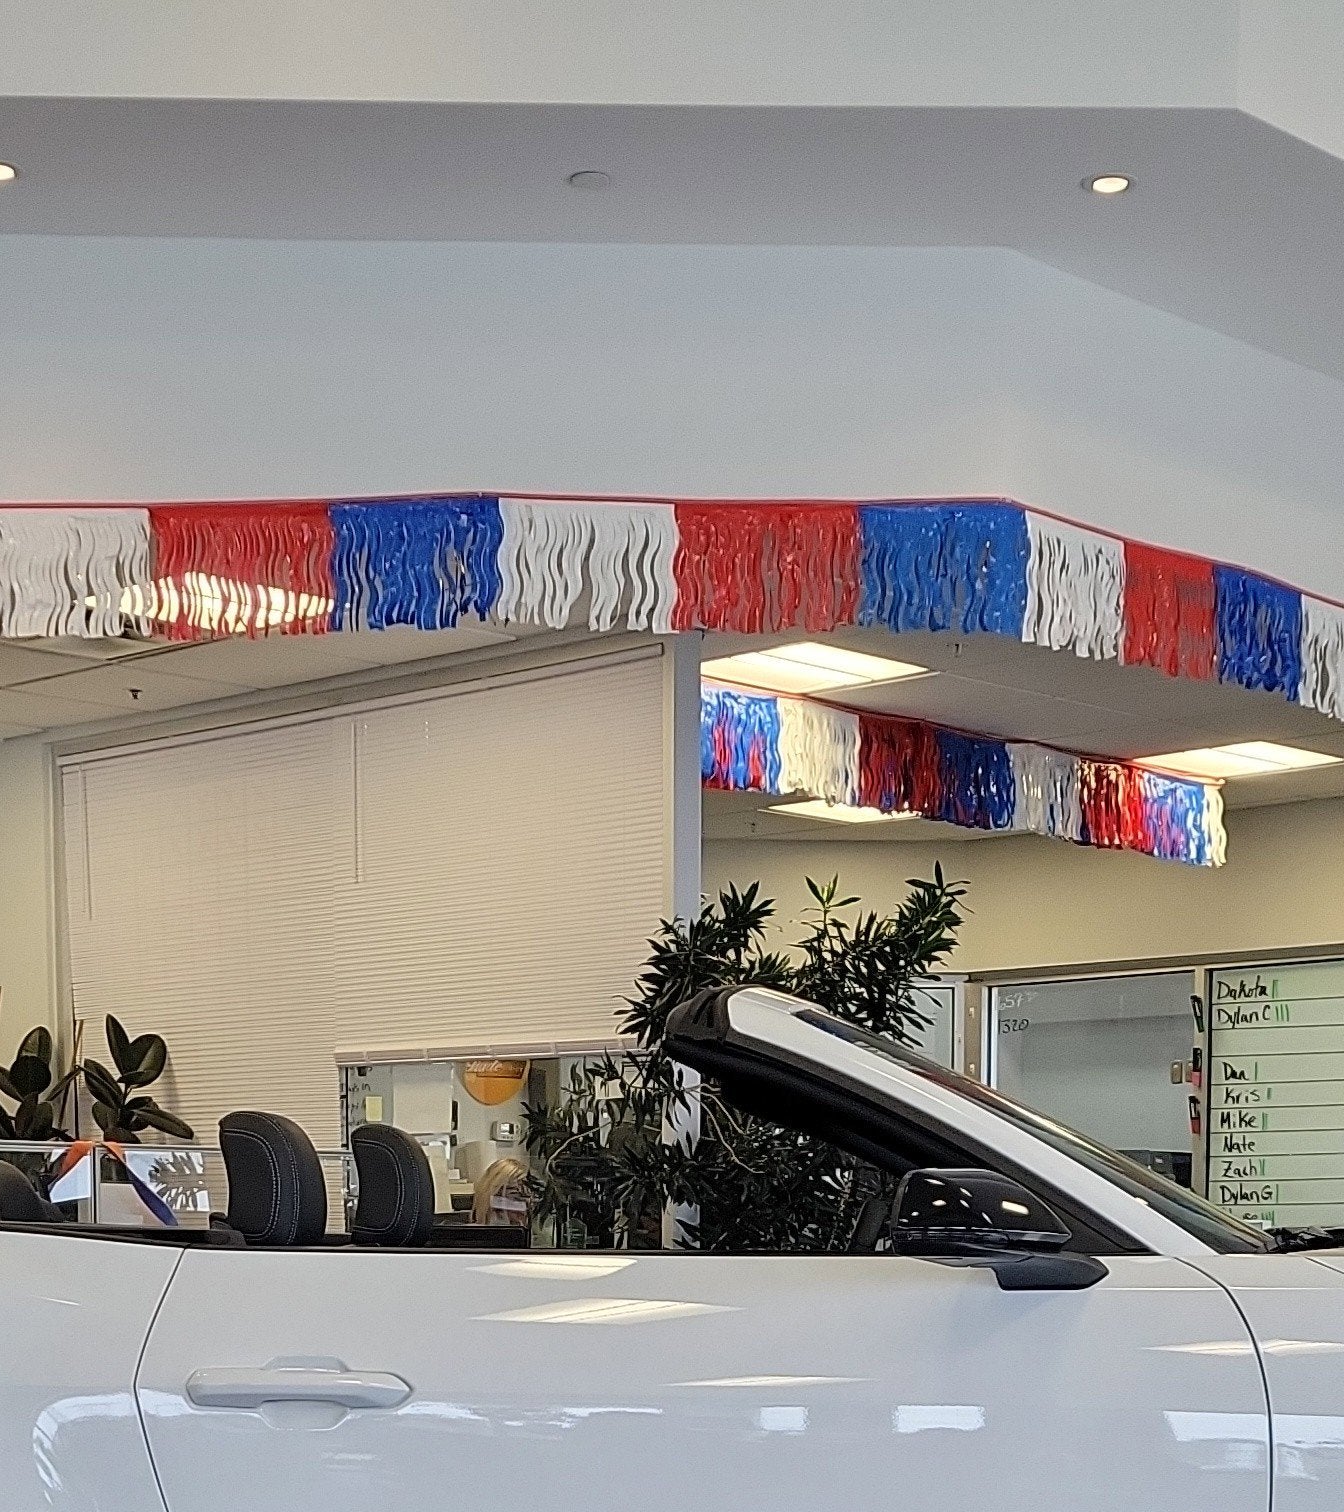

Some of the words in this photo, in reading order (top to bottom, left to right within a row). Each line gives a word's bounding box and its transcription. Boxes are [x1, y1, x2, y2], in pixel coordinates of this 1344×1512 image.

[1217, 975, 1268, 999] Dakota
[1224, 1086, 1260, 1104] Kris
[1222, 1136, 1255, 1152] Nate
[1221, 1159, 1257, 1177] Zach
